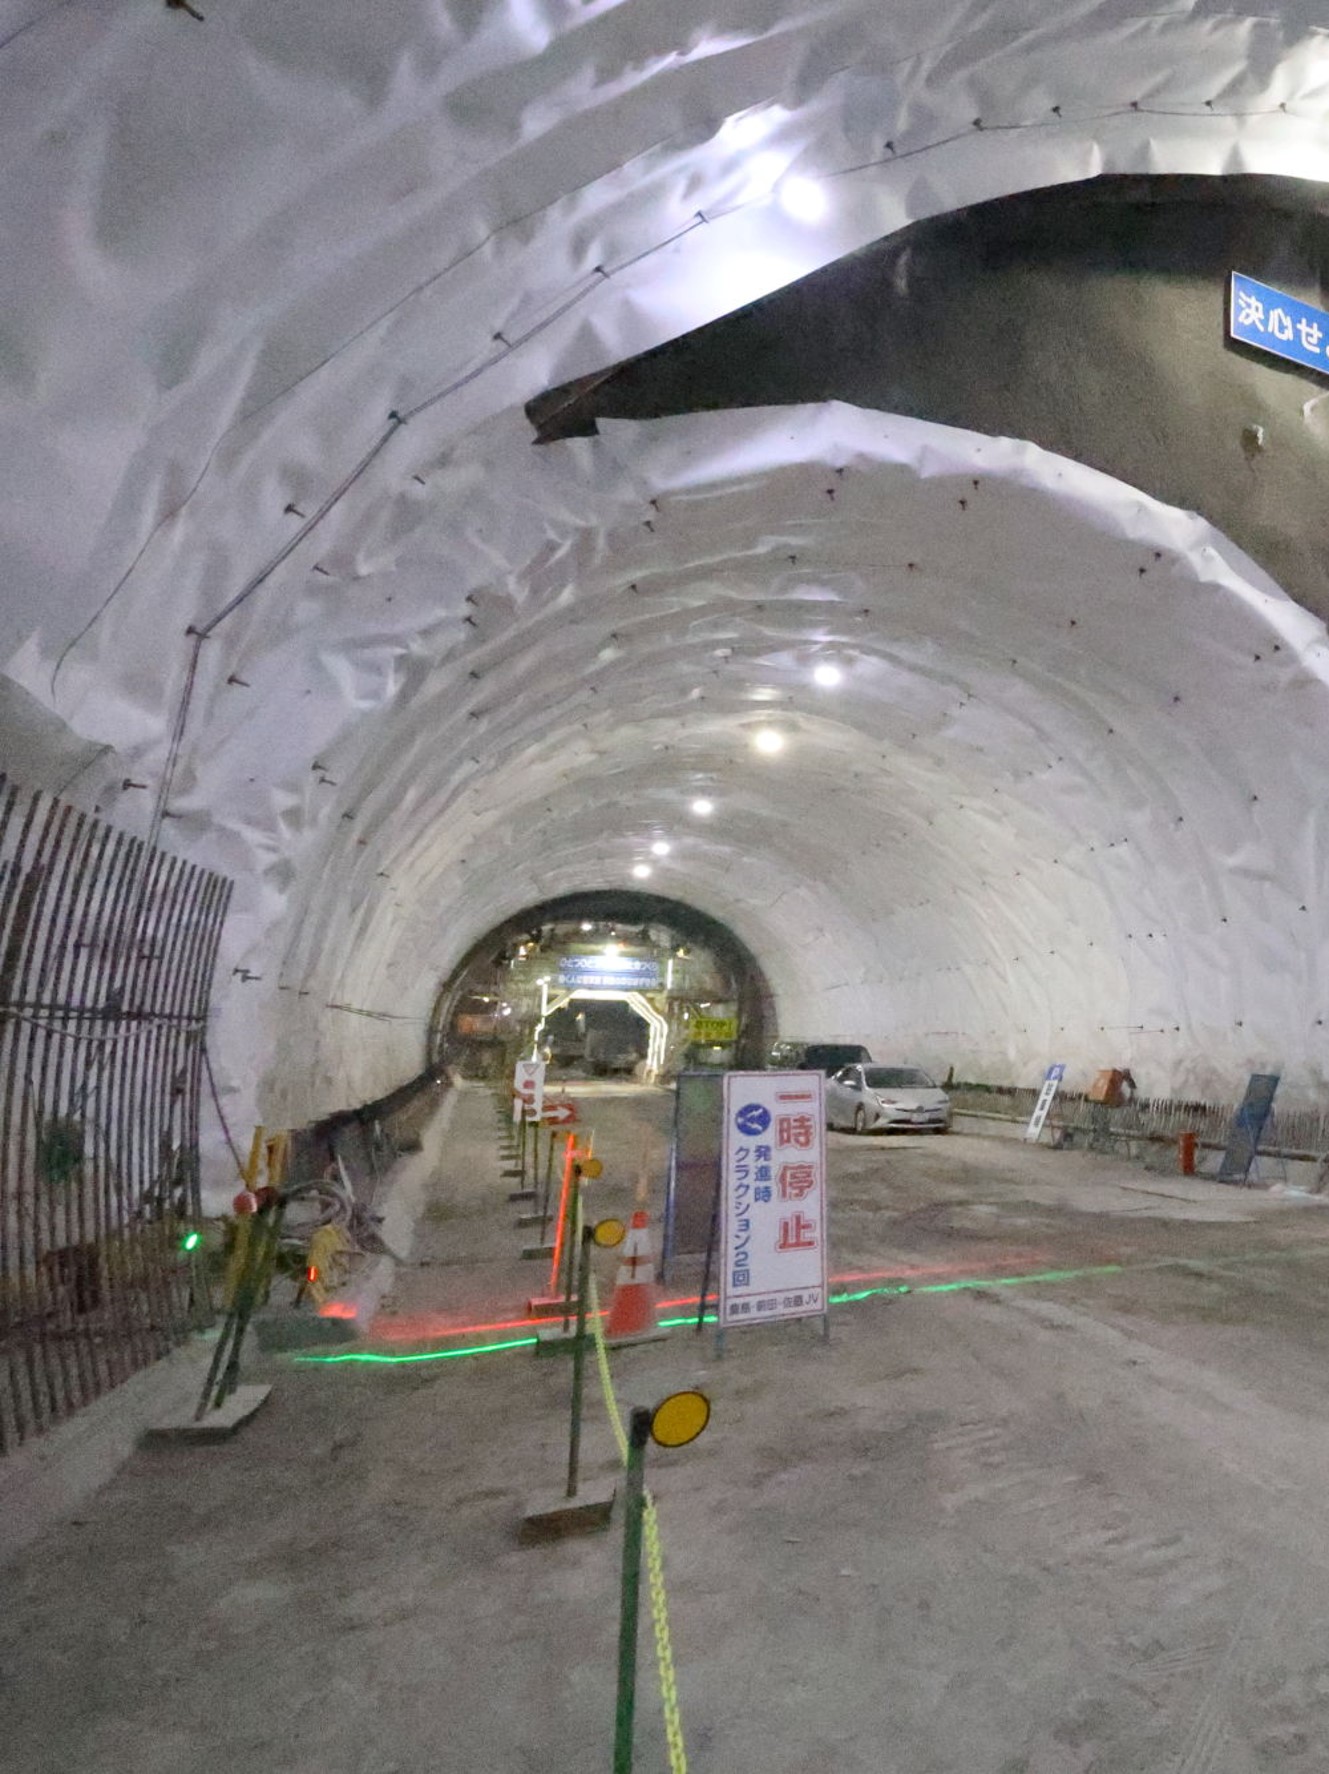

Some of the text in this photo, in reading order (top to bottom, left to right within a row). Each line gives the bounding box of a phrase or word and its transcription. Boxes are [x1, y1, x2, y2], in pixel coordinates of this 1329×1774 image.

[732, 1146, 750, 1288] クラクション2回
[754, 1145, 773, 1203] 発進時
[778, 1092, 816, 1251] 一時停止
